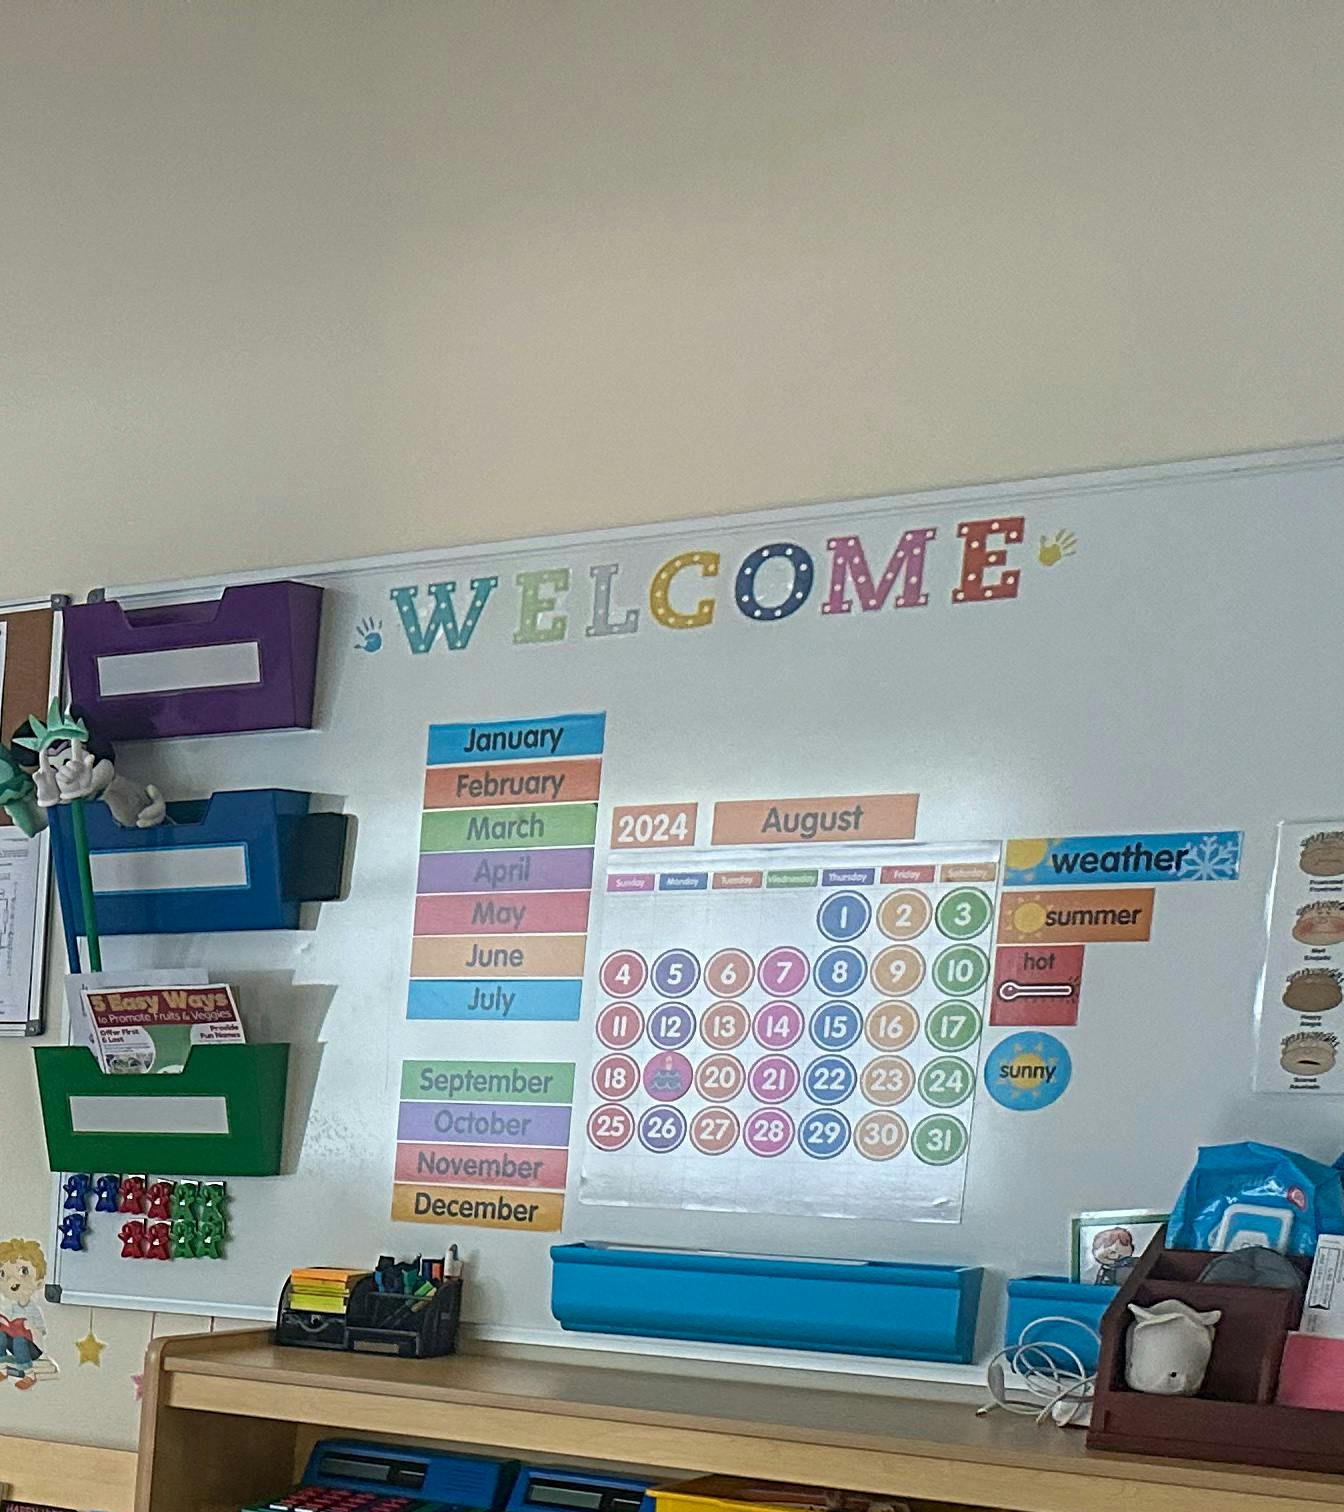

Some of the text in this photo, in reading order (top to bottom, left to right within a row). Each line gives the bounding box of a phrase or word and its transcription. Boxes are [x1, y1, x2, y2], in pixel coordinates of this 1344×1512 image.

[390, 516, 1025, 655] WELCOME
[464, 727, 564, 754] January
[457, 771, 565, 798] February
[467, 815, 544, 841] March
[618, 812, 688, 843] 2024
[761, 805, 864, 839] August
[1052, 842, 1189, 874] weather
[474, 856, 531, 888] April
[615, 878, 645, 890] Sunday
[666, 877, 700, 888] Monday
[721, 876, 753, 887] Tuesday
[829, 872, 868, 884] Thursday
[893, 869, 921, 881] Friday
[471, 902, 527, 929] May
[840, 902, 972, 929] 1 2 3
[1045, 907, 1142, 926] summer
[466, 944, 524, 968] June
[1023, 952, 1056, 971] hot
[615, 959, 974, 986] 4 5 6 7 8 9 10
[91, 990, 229, 1014] 5 Easy Ways
[467, 986, 516, 1017] July
[98, 1016, 108, 1024] to
[108, 1013, 151, 1024] Promote
[154, 1011, 181, 1021] Fruits
[192, 1010, 232, 1022] Veggies
[612, 1015, 967, 1039] 11 12 13 14 15 16 17
[200, 1032, 216, 1040] Fun
[420, 1067, 554, 1098] September
[604, 1066, 963, 1093] 18 20 21 22 23 24
[1000, 1063, 1057, 1083] sunny
[434, 1110, 532, 1137] October
[596, 1115, 952, 1152] 25 26 27 28 29 30 31
[417, 1152, 544, 1180] November
[415, 1192, 539, 1223] December
